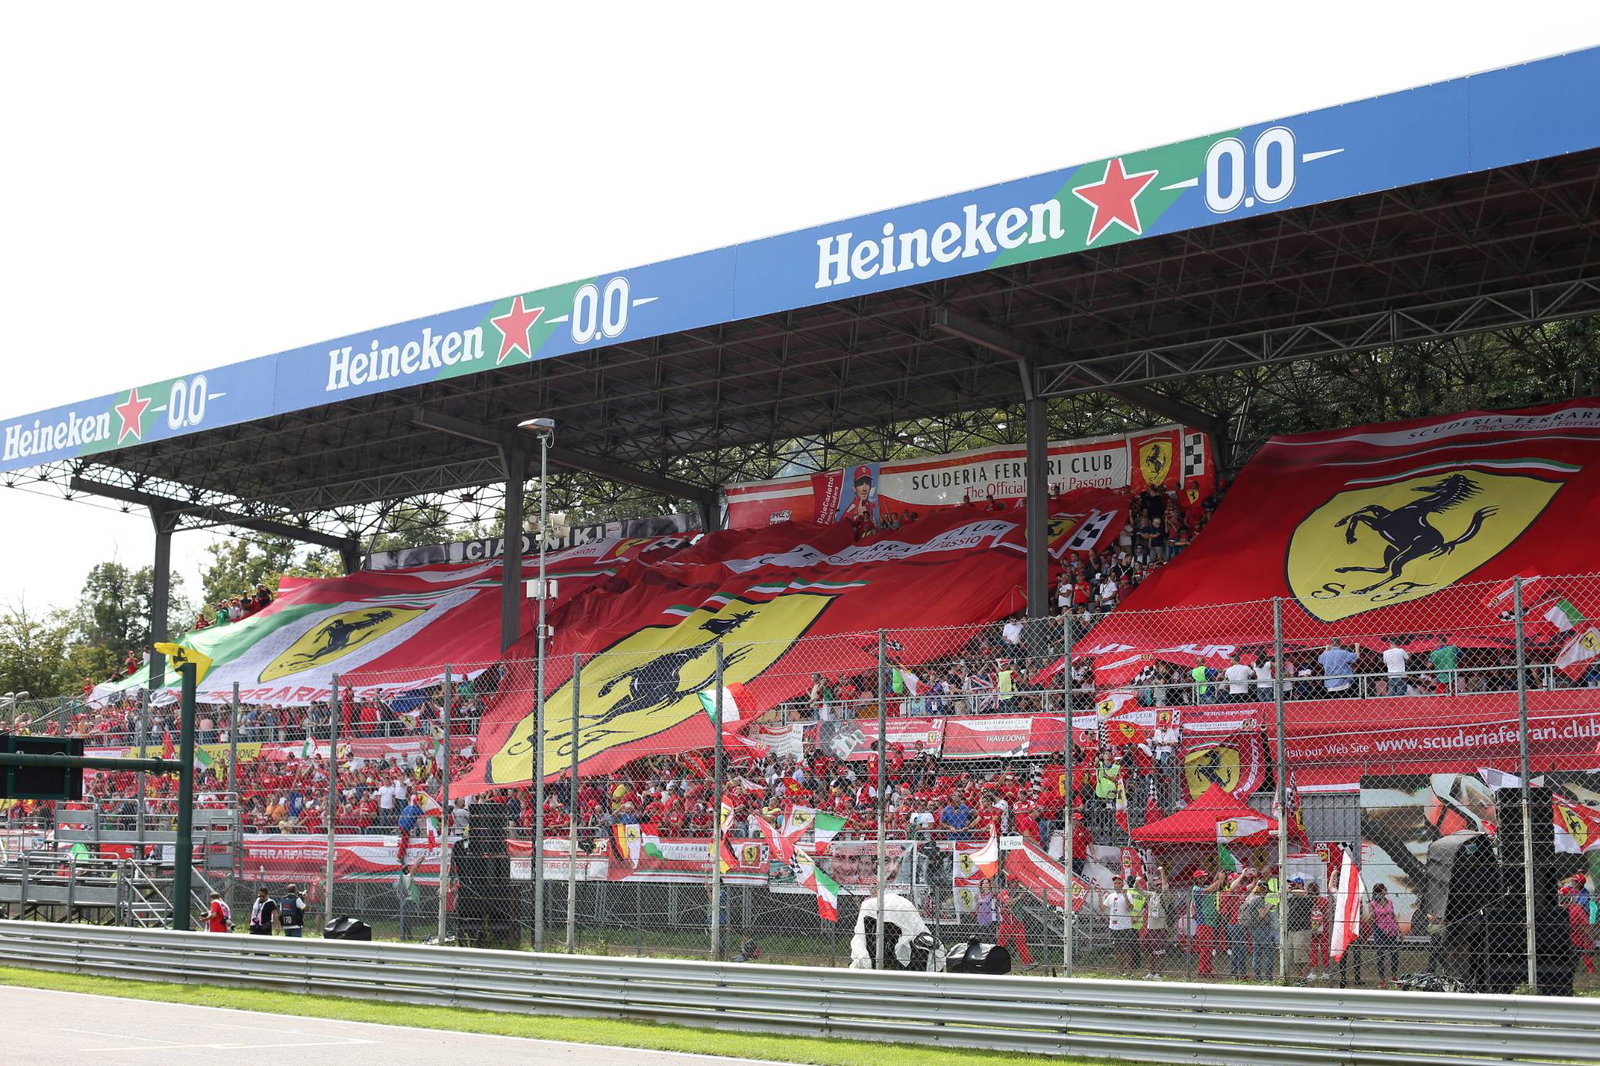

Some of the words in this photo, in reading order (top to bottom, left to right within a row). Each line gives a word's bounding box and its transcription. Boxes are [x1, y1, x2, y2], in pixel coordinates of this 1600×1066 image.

[815, 198, 1065, 289] Heineken
[1203, 126, 1296, 214] 0.0
[326, 326, 484, 391] Heineken
[571, 276, 630, 344] 0.0
[3, 411, 110, 461] Heineken
[168, 374, 207, 430] 0.0
[912, 466, 987, 491] SCUDERIA
[994, 459, 1062, 479] FERRI
[1071, 455, 1113, 474] CLUB
[964, 486, 984, 499] The
[987, 481, 1027, 497] Official
[1069, 477, 1113, 490] Passion
[931, 720, 942, 730] 27
[1285, 747, 1303, 758] isit
[1304, 748, 1322, 757] our
[1325, 744, 1348, 754] Web
[1350, 743, 1370, 753] Site
